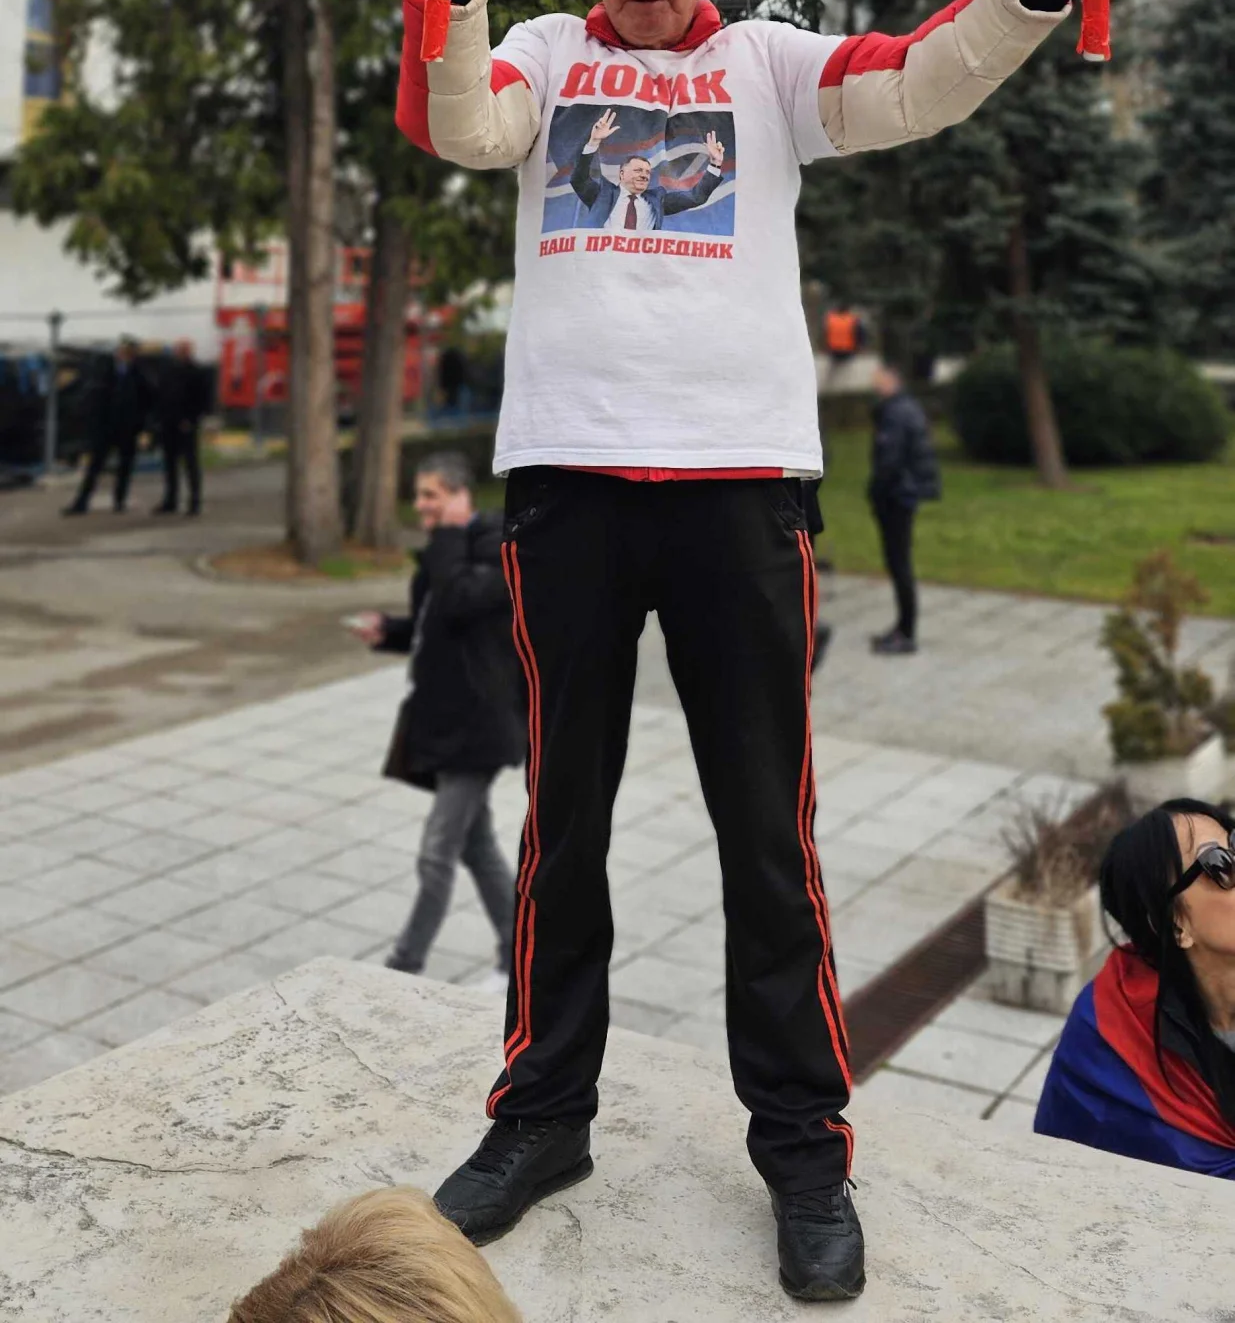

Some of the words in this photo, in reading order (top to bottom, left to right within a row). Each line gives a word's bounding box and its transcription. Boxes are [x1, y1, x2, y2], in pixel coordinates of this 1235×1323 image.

[559, 61, 732, 106] ДОДИК
[539, 235, 576, 257] НАШ
[585, 235, 733, 259] ПРЕДСЈЕДНИК
